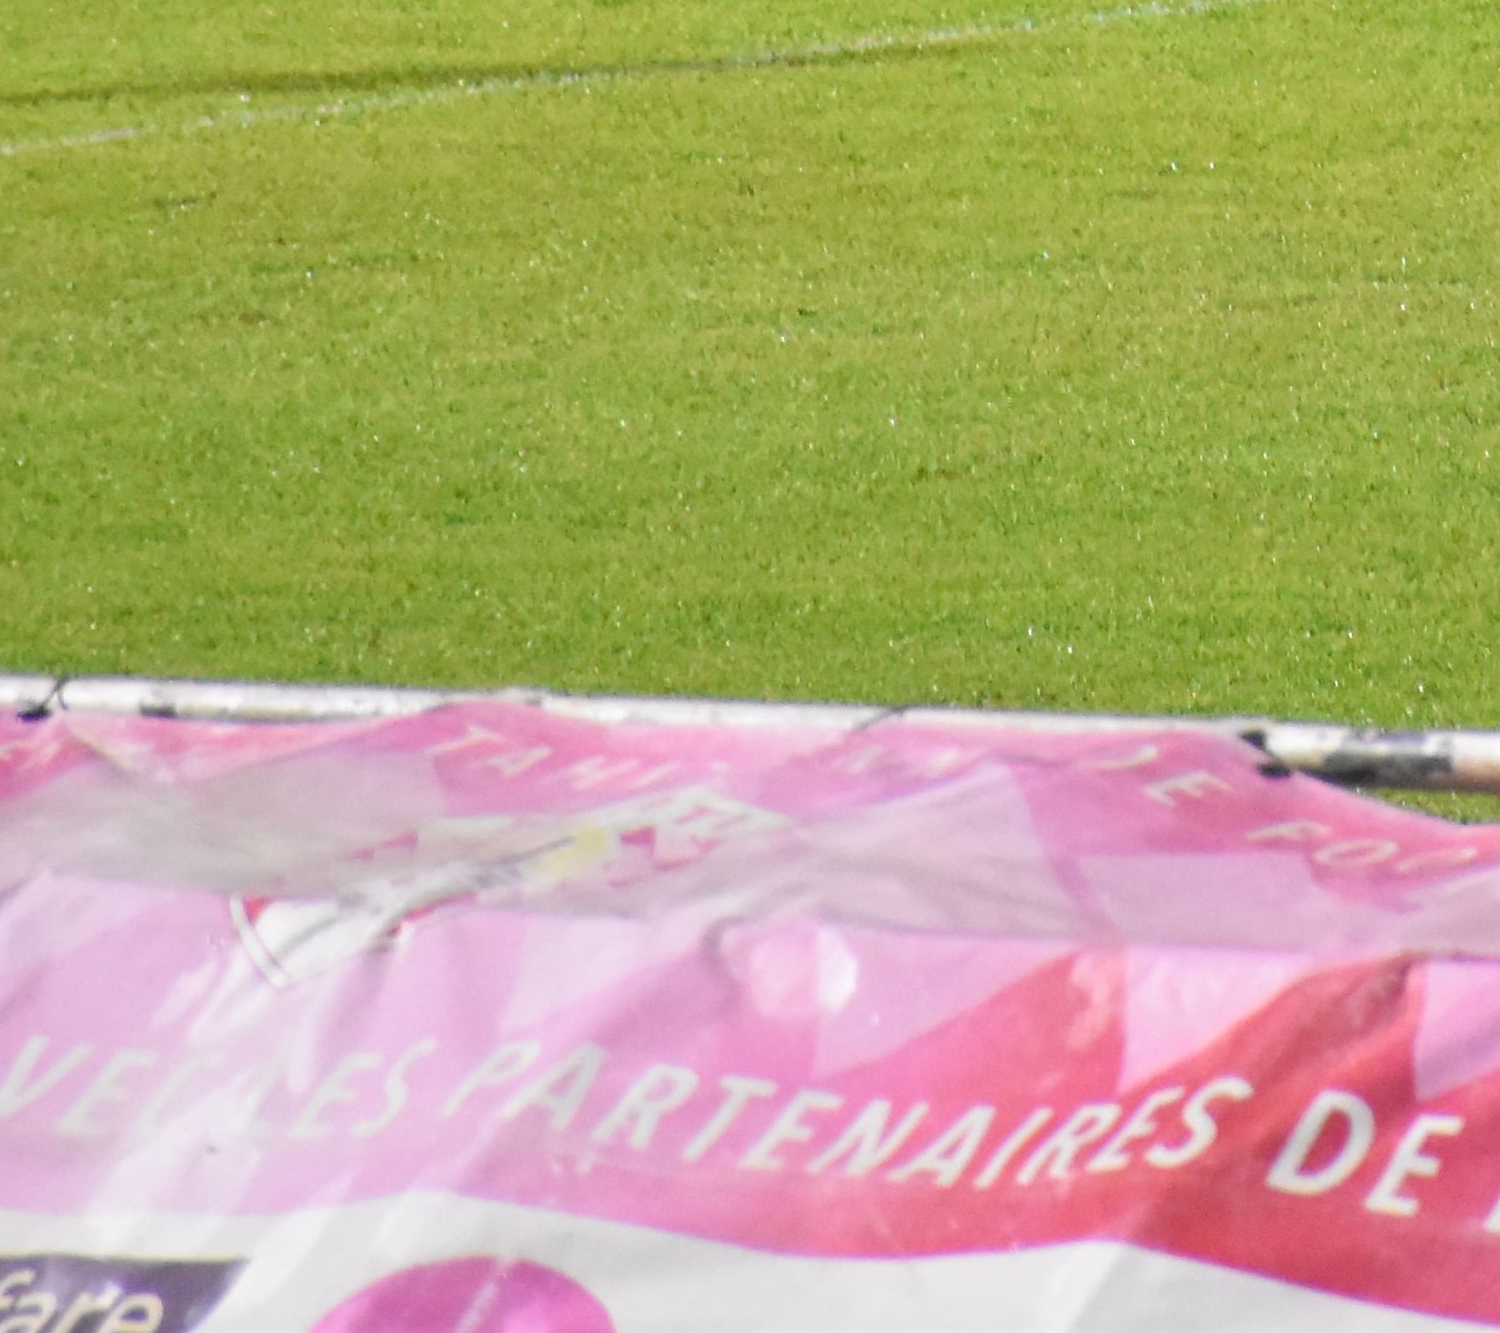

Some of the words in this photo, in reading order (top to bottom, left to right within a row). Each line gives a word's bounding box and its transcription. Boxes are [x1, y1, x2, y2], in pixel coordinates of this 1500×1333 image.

[244, 1033, 438, 1137] LES
[442, 1038, 1255, 1190] PARTENAIRES
[1265, 1088, 1466, 1218] DE
